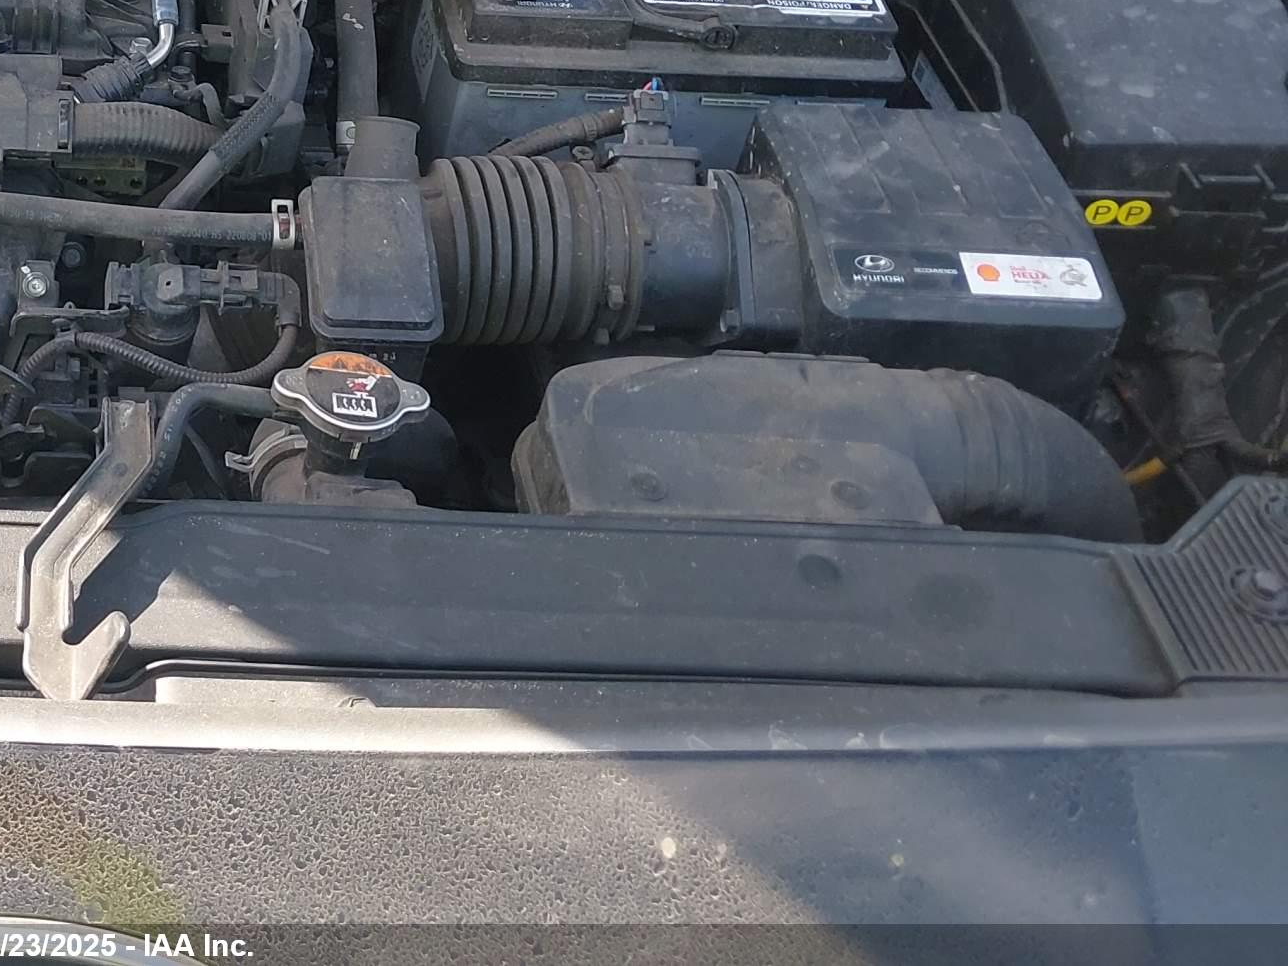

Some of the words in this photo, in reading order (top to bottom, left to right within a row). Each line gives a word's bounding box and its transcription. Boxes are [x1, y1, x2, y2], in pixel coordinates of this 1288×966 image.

[1092, 205, 1112, 221] P
[1125, 206, 1144, 222] P
[852, 273, 905, 283] HYUNDAI
[1011, 271, 1051, 280] HELIX
